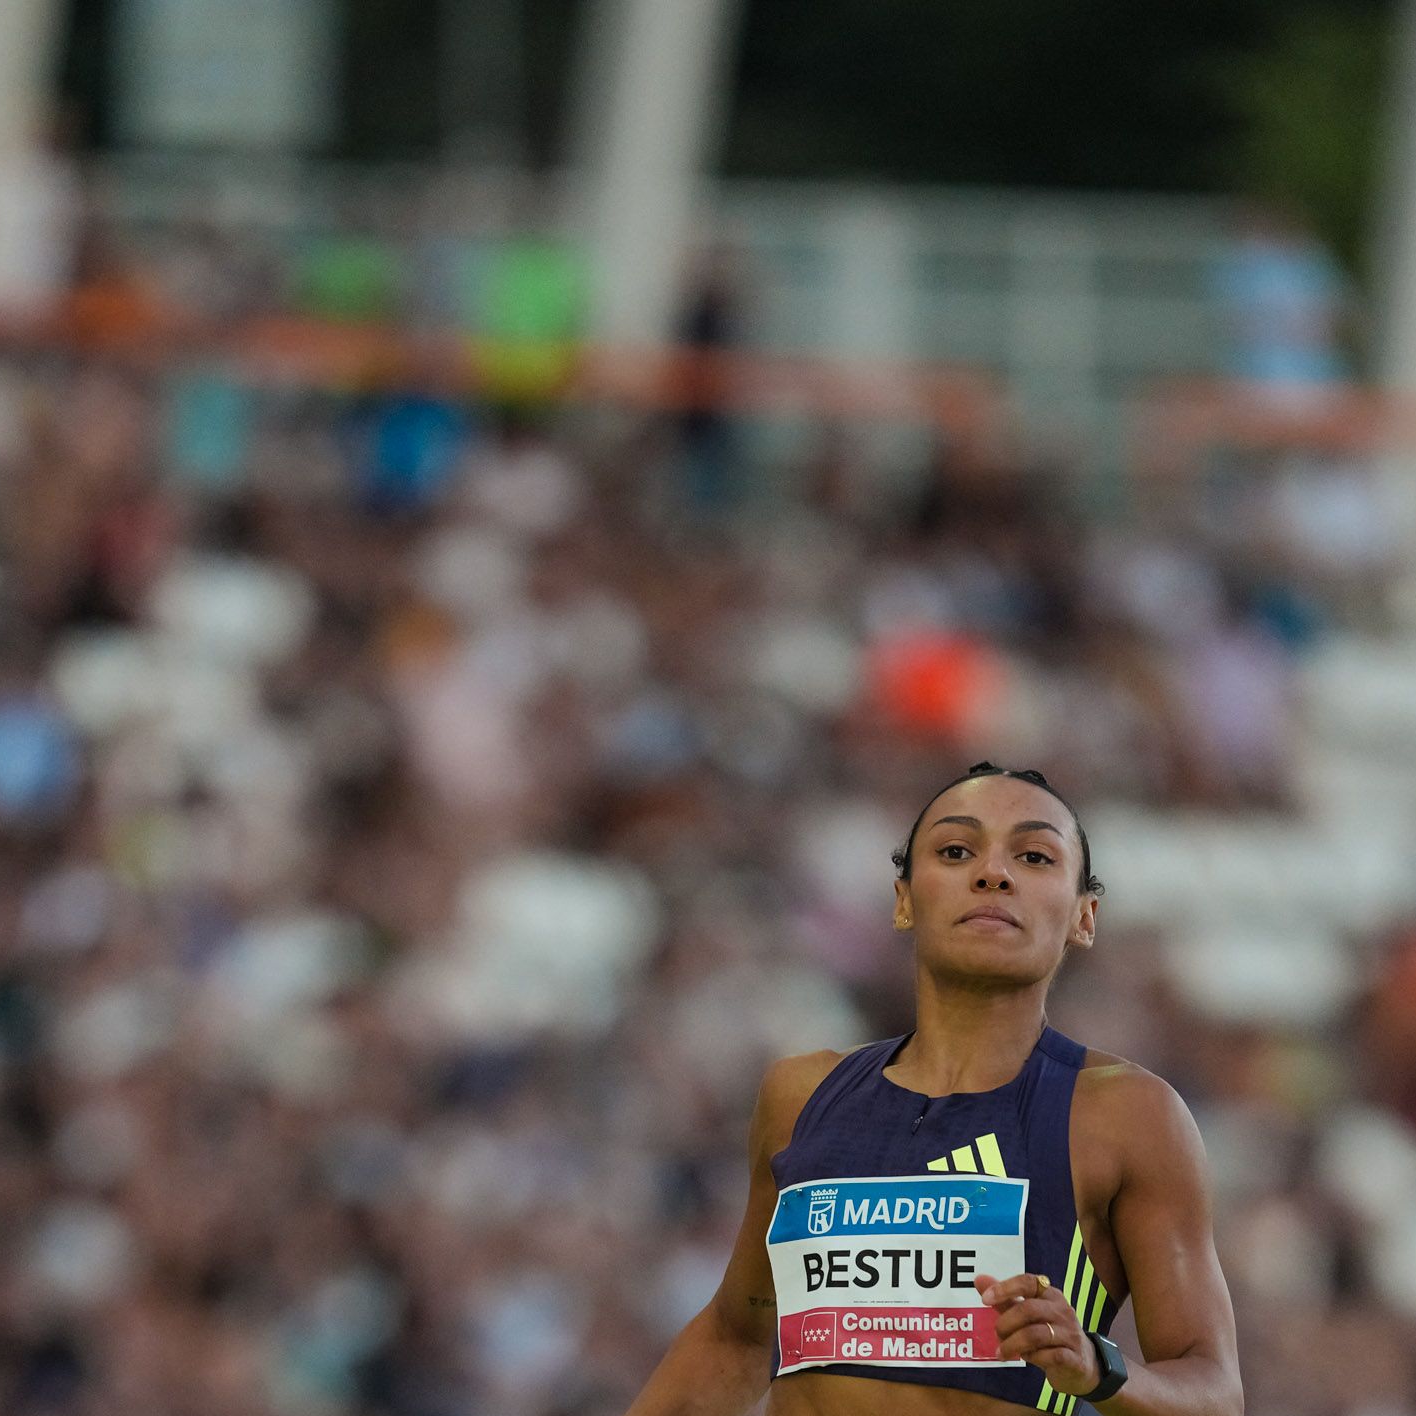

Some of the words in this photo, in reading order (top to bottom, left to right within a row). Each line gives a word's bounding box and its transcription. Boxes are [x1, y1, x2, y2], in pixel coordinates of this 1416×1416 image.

[842, 1196, 970, 1231] MADRID
[803, 1249, 976, 1292] BESTUE
[842, 1312, 974, 1332] Comunidad
[841, 1337, 873, 1358] de
[882, 1337, 974, 1358] Madrid
